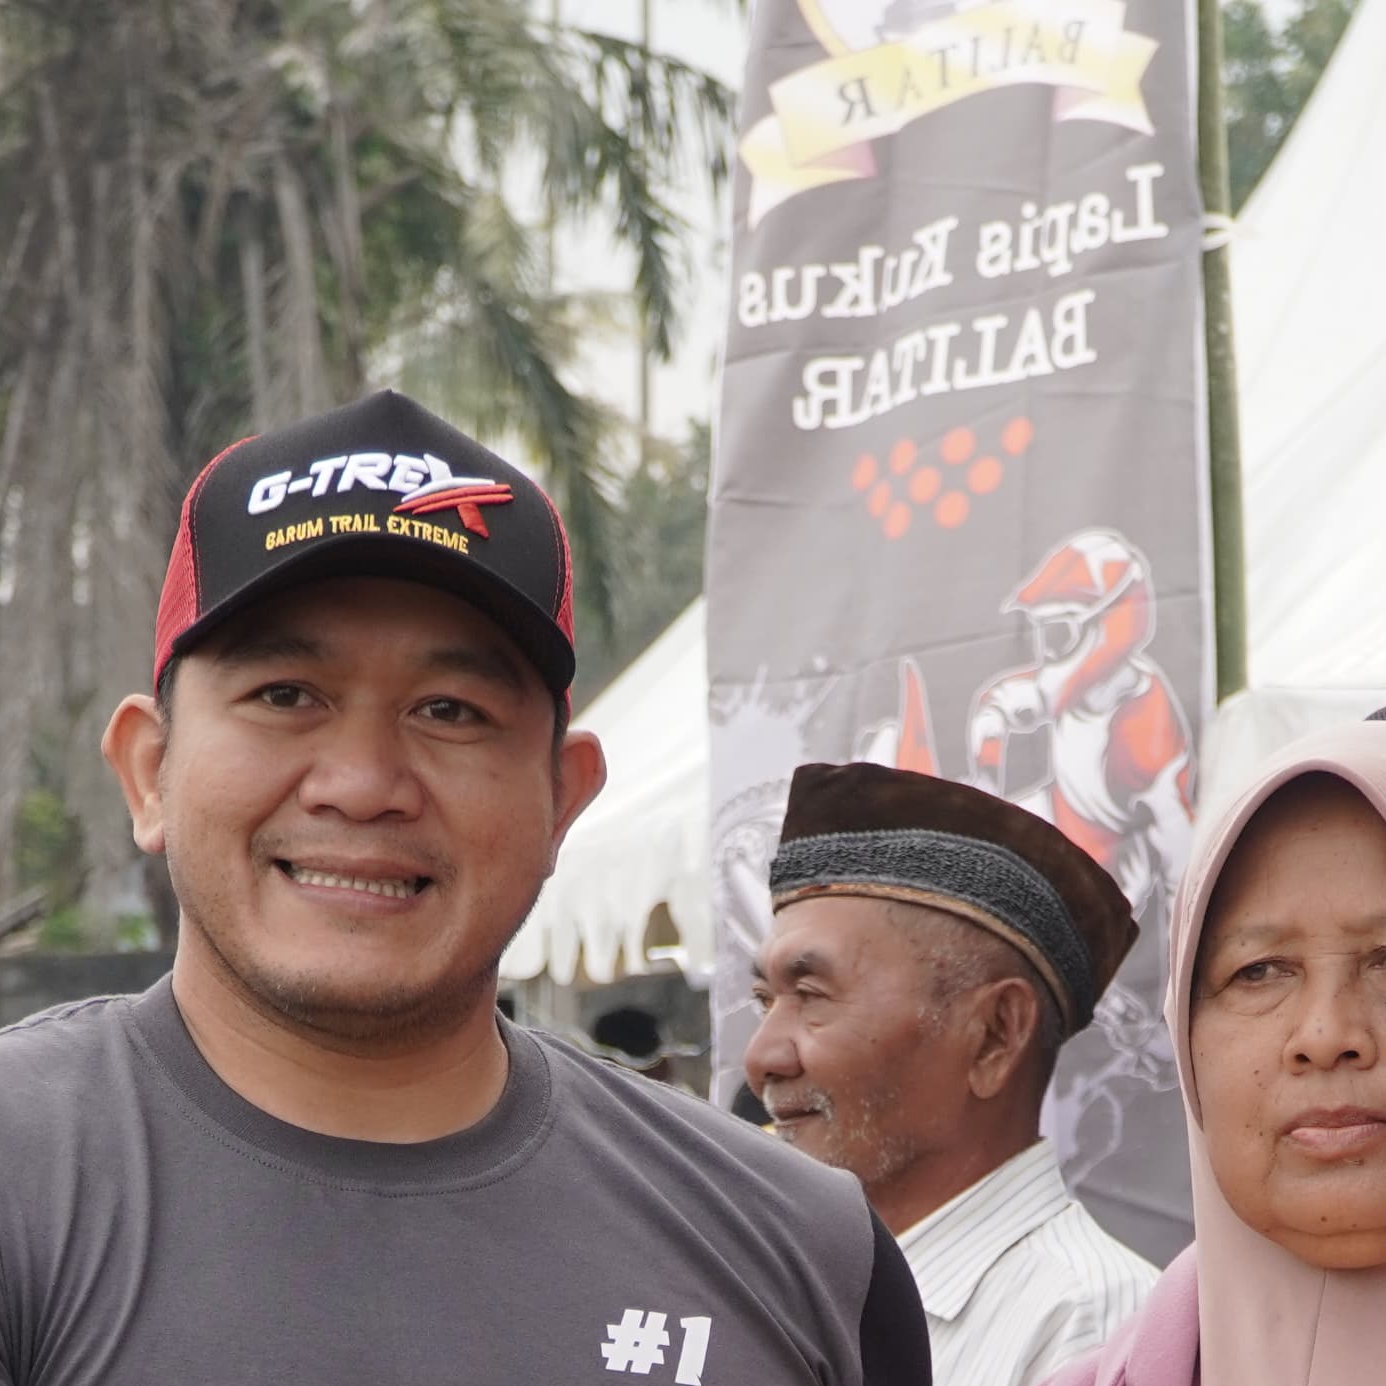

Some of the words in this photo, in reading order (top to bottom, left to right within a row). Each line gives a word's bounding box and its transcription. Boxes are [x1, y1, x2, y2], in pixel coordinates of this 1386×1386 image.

[247, 453, 513, 538] G-TREX
[265, 517, 323, 551] GARUM
[329, 513, 381, 533] TRAIL
[386, 515, 470, 555] EXTREME
[599, 1308, 712, 1386] #1
